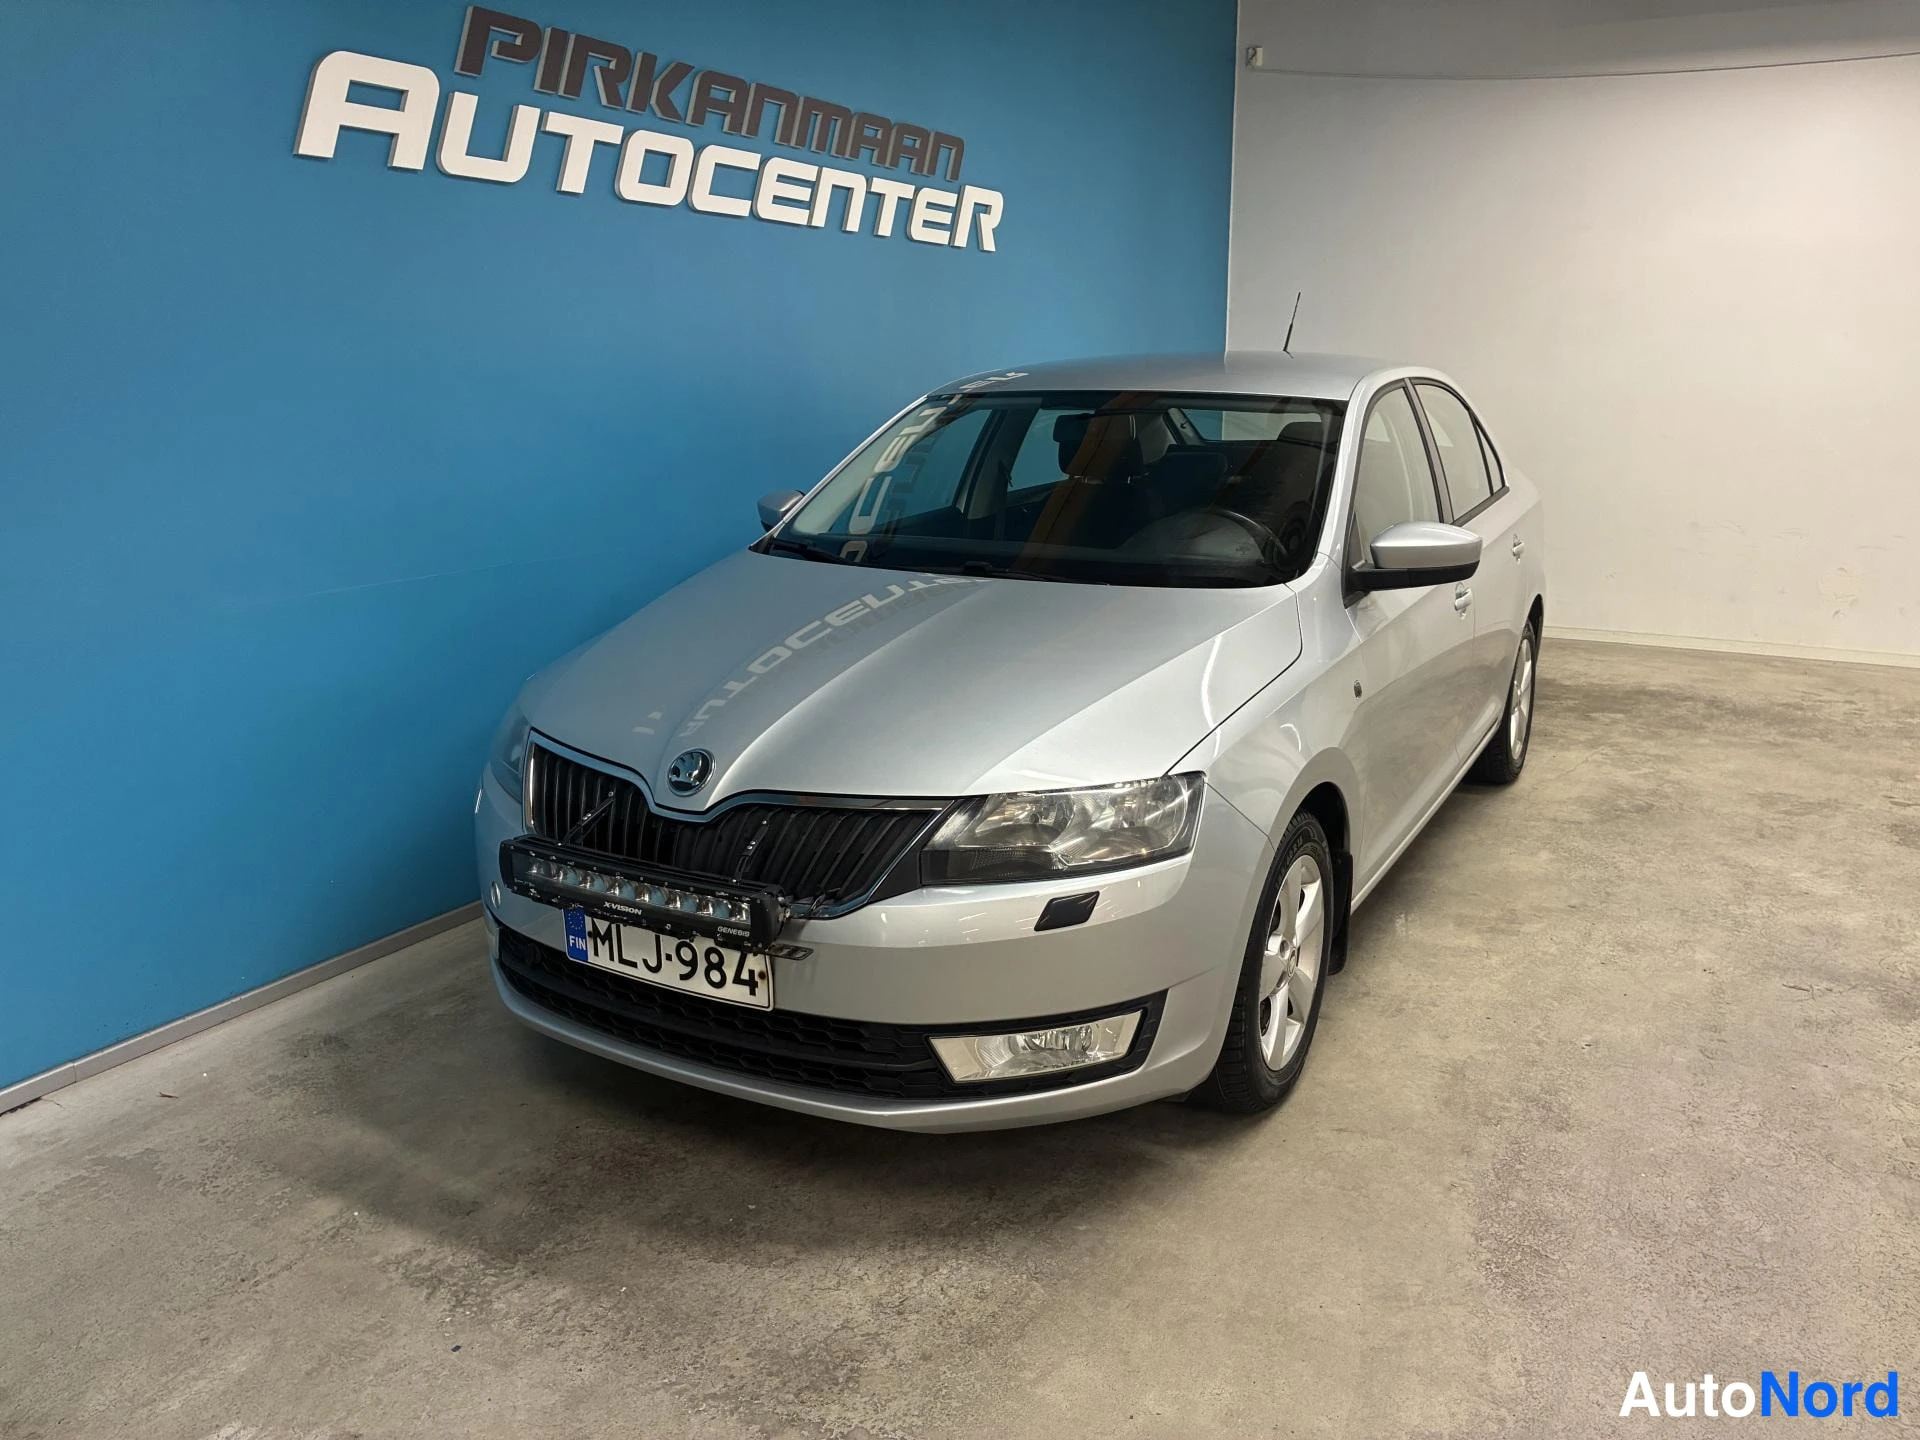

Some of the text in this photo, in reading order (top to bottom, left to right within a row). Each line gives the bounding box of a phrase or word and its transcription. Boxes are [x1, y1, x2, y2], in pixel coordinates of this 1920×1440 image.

[455, 5, 965, 181] PIRKANMAAN
[293, 50, 1004, 253] AUTOCENTER
[601, 901, 643, 916] X-VISION
[717, 925, 751, 938] GENESIS
[569, 934, 587, 951] FIN
[591, 917, 759, 997] MLJ-984
